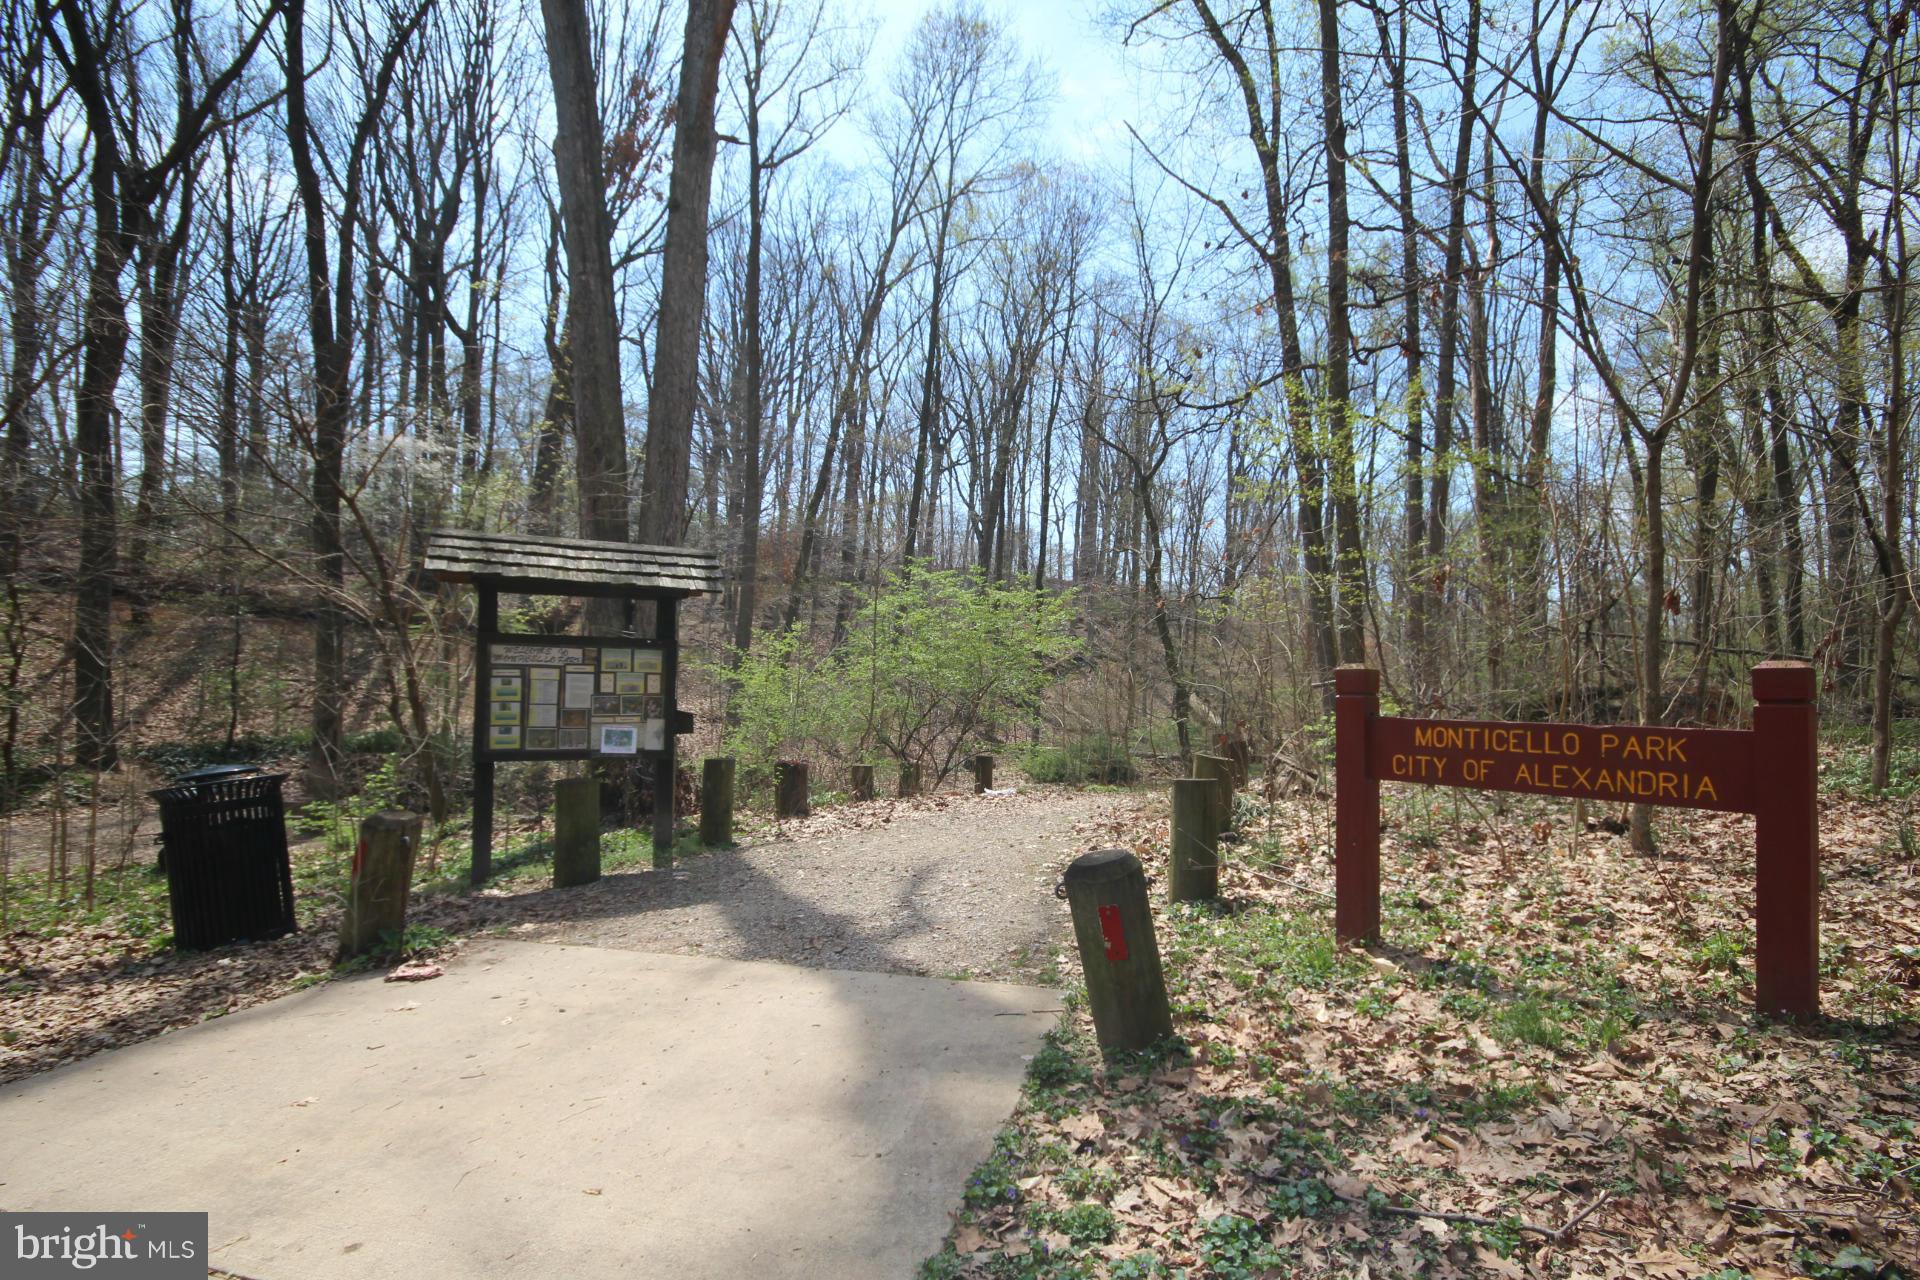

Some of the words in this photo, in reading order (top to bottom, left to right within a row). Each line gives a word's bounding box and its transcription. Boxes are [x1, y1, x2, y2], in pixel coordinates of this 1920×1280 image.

[1415, 726, 1580, 755] MONTICELLO
[1600, 733, 1688, 762] PARK
[1392, 754, 1449, 778] CITY
[1463, 759, 1495, 781] OF
[1514, 764, 1718, 801] ALEXANDRIA
